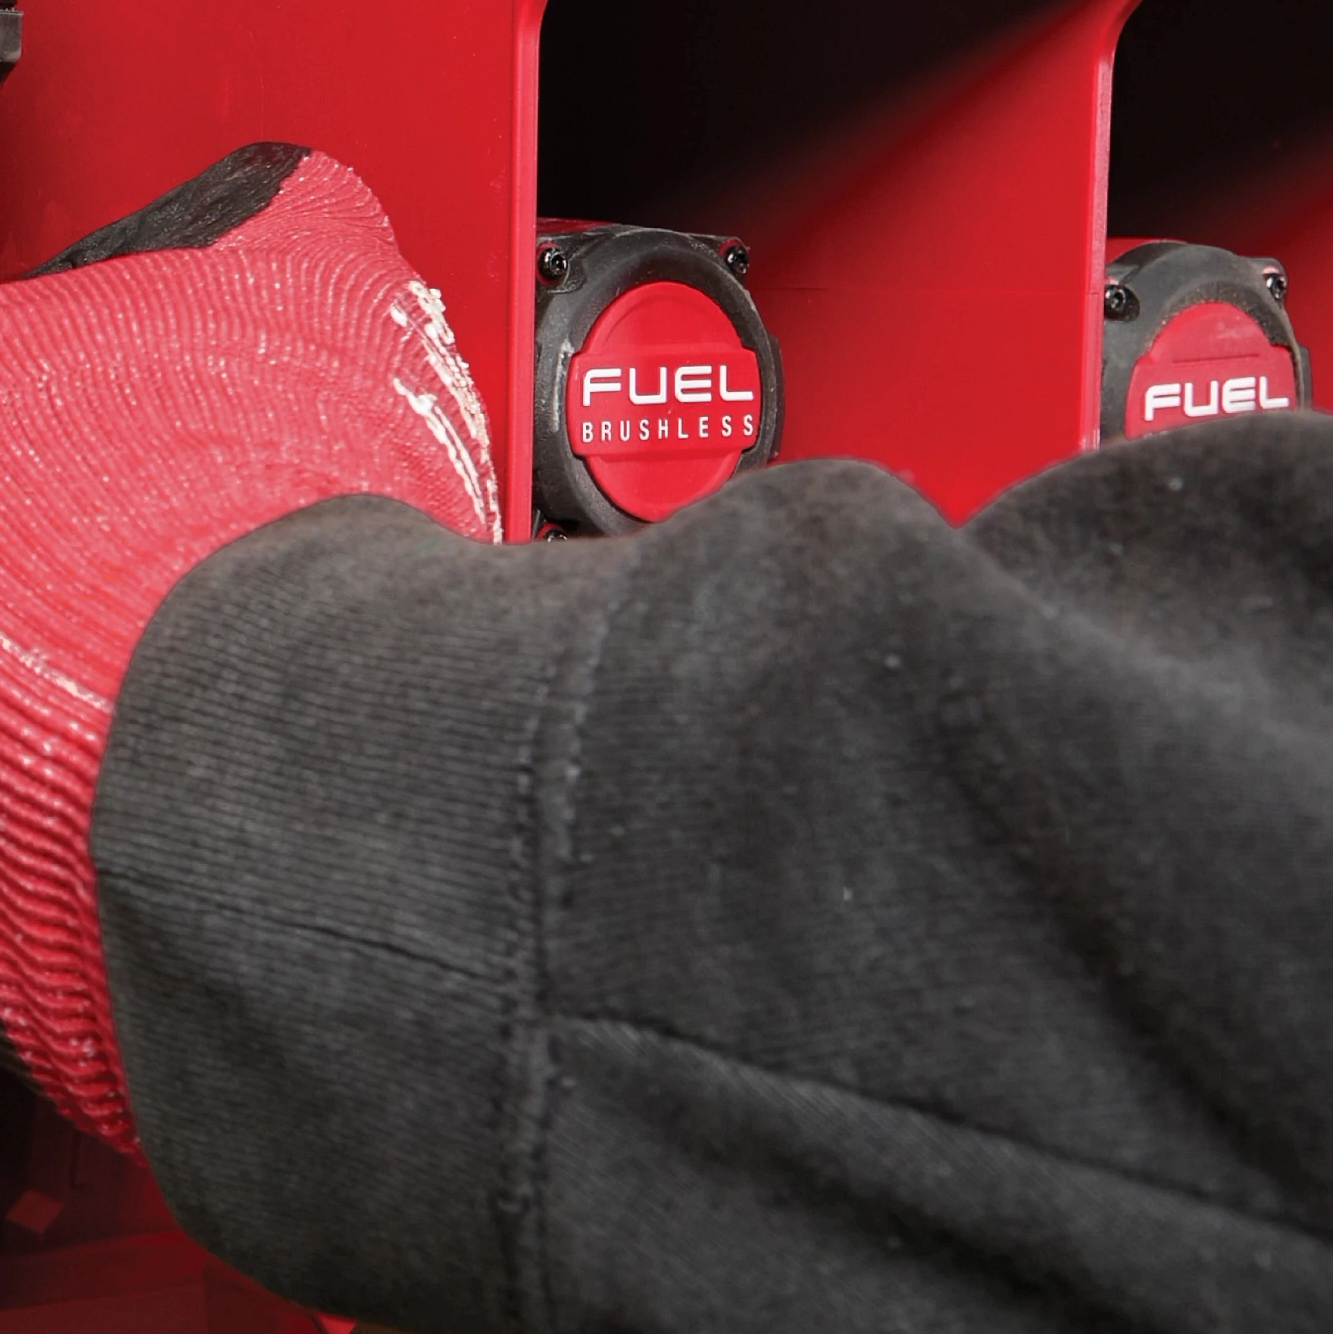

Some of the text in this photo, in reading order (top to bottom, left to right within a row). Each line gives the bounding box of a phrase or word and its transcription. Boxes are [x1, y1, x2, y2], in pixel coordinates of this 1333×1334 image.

[583, 365, 753, 406] FUEL
[1145, 376, 1289, 421] FUEL
[583, 414, 753, 443] BRUSHLESS
